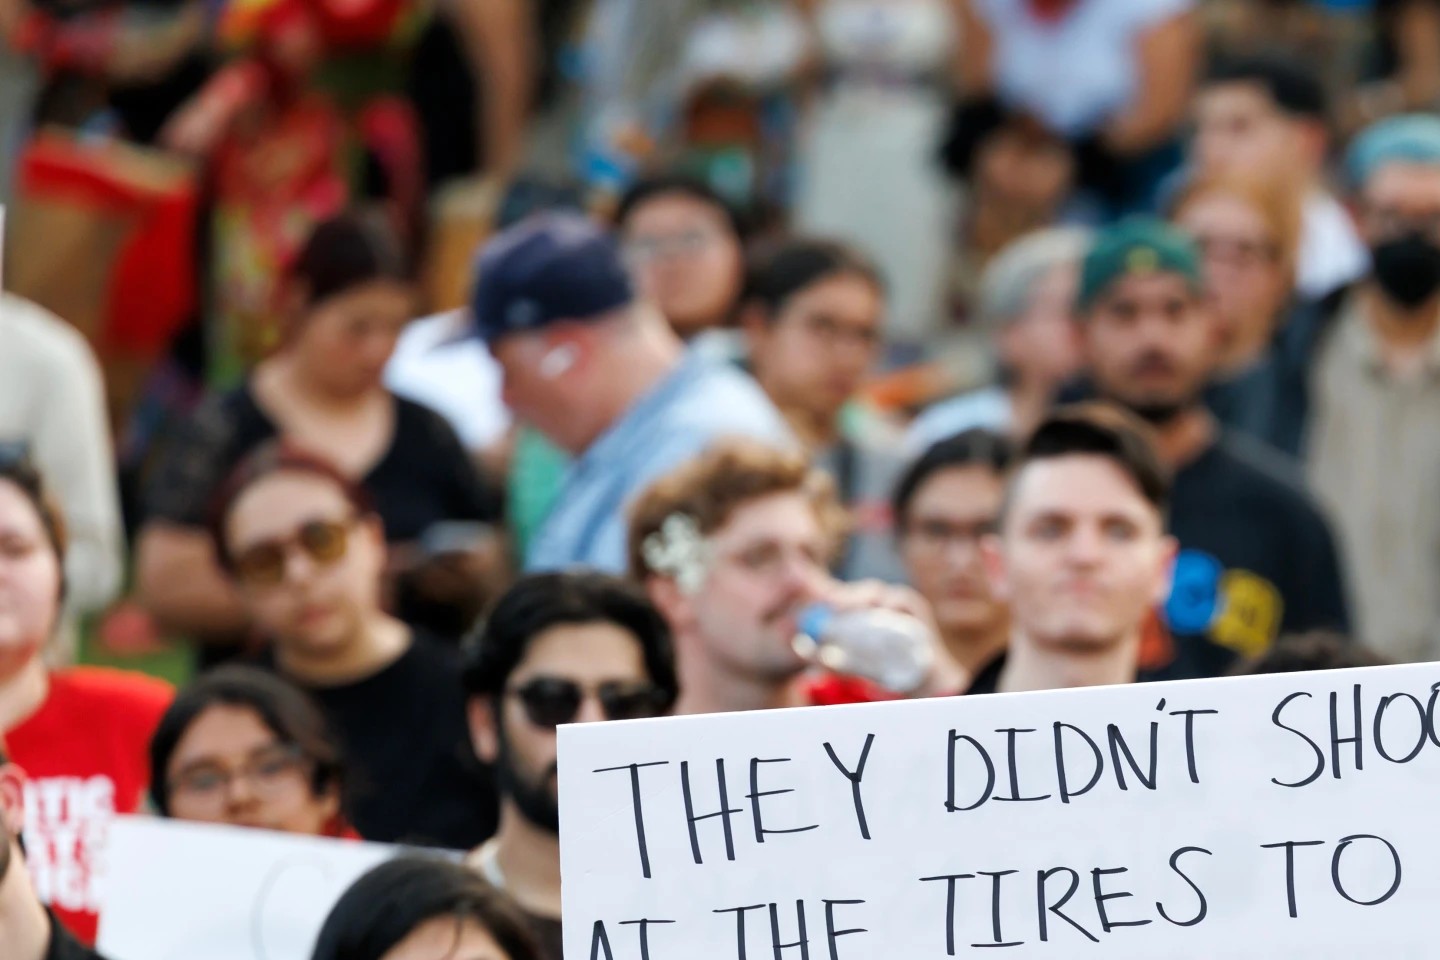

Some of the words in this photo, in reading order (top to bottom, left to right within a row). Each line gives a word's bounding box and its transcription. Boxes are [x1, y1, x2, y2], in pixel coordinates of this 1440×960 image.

[592, 733, 875, 878] THEY
[944, 698, 1218, 813] DIDN'T
[919, 846, 1213, 956] TIRES
[1260, 834, 1402, 918] TO
